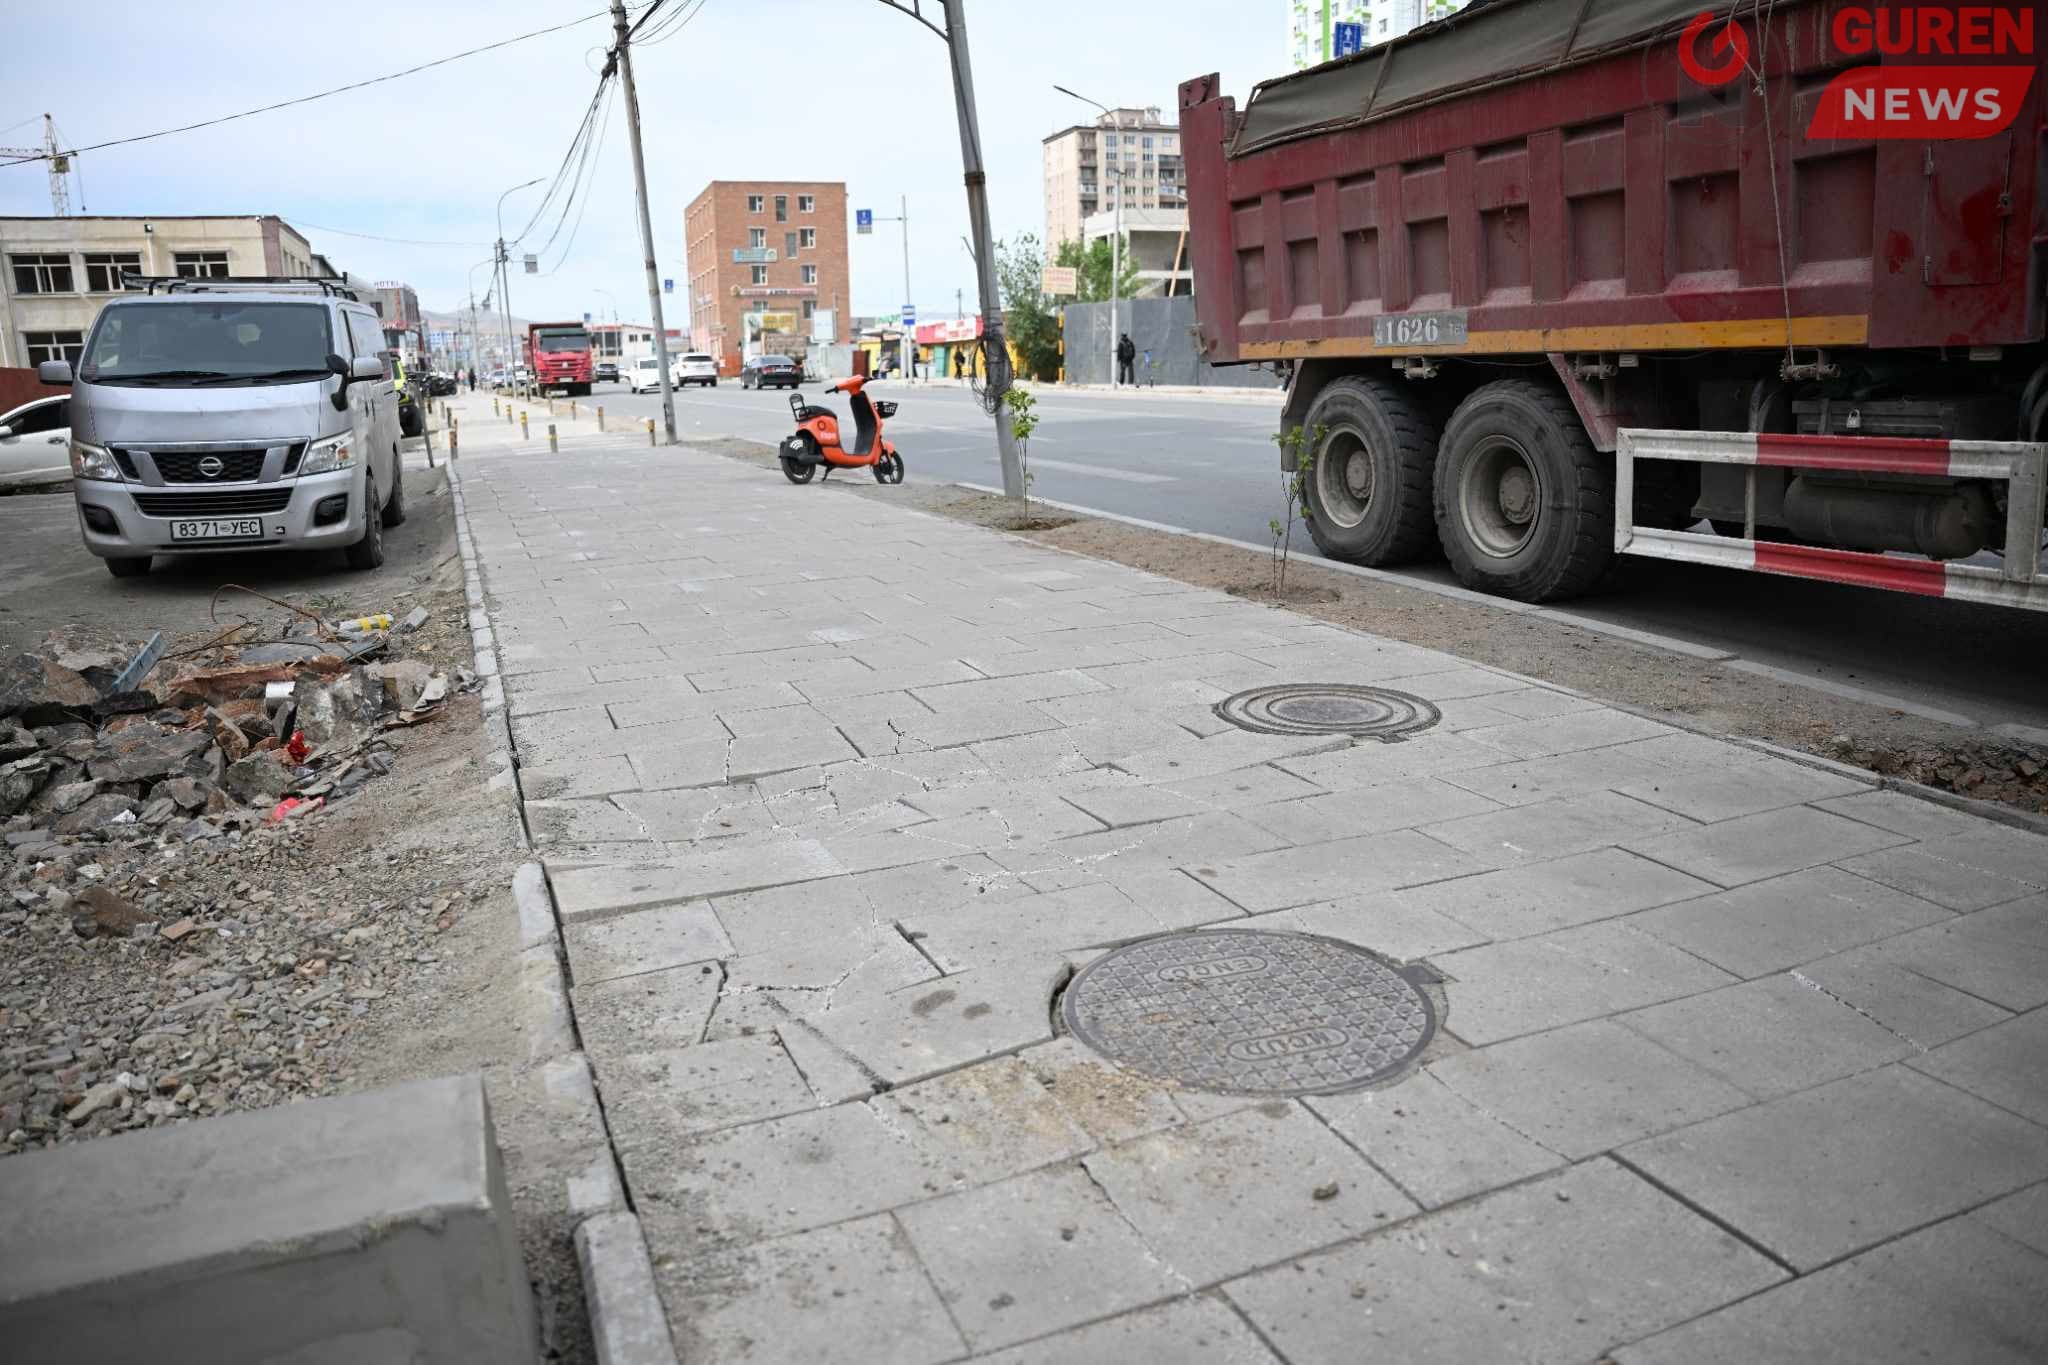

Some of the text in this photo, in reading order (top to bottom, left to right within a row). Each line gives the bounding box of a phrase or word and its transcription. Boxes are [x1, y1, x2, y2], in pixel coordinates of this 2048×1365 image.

[374, 280, 401, 288] HOTEL
[1386, 318, 1439, 345] 1626
[179, 522, 218, 537] 8371
